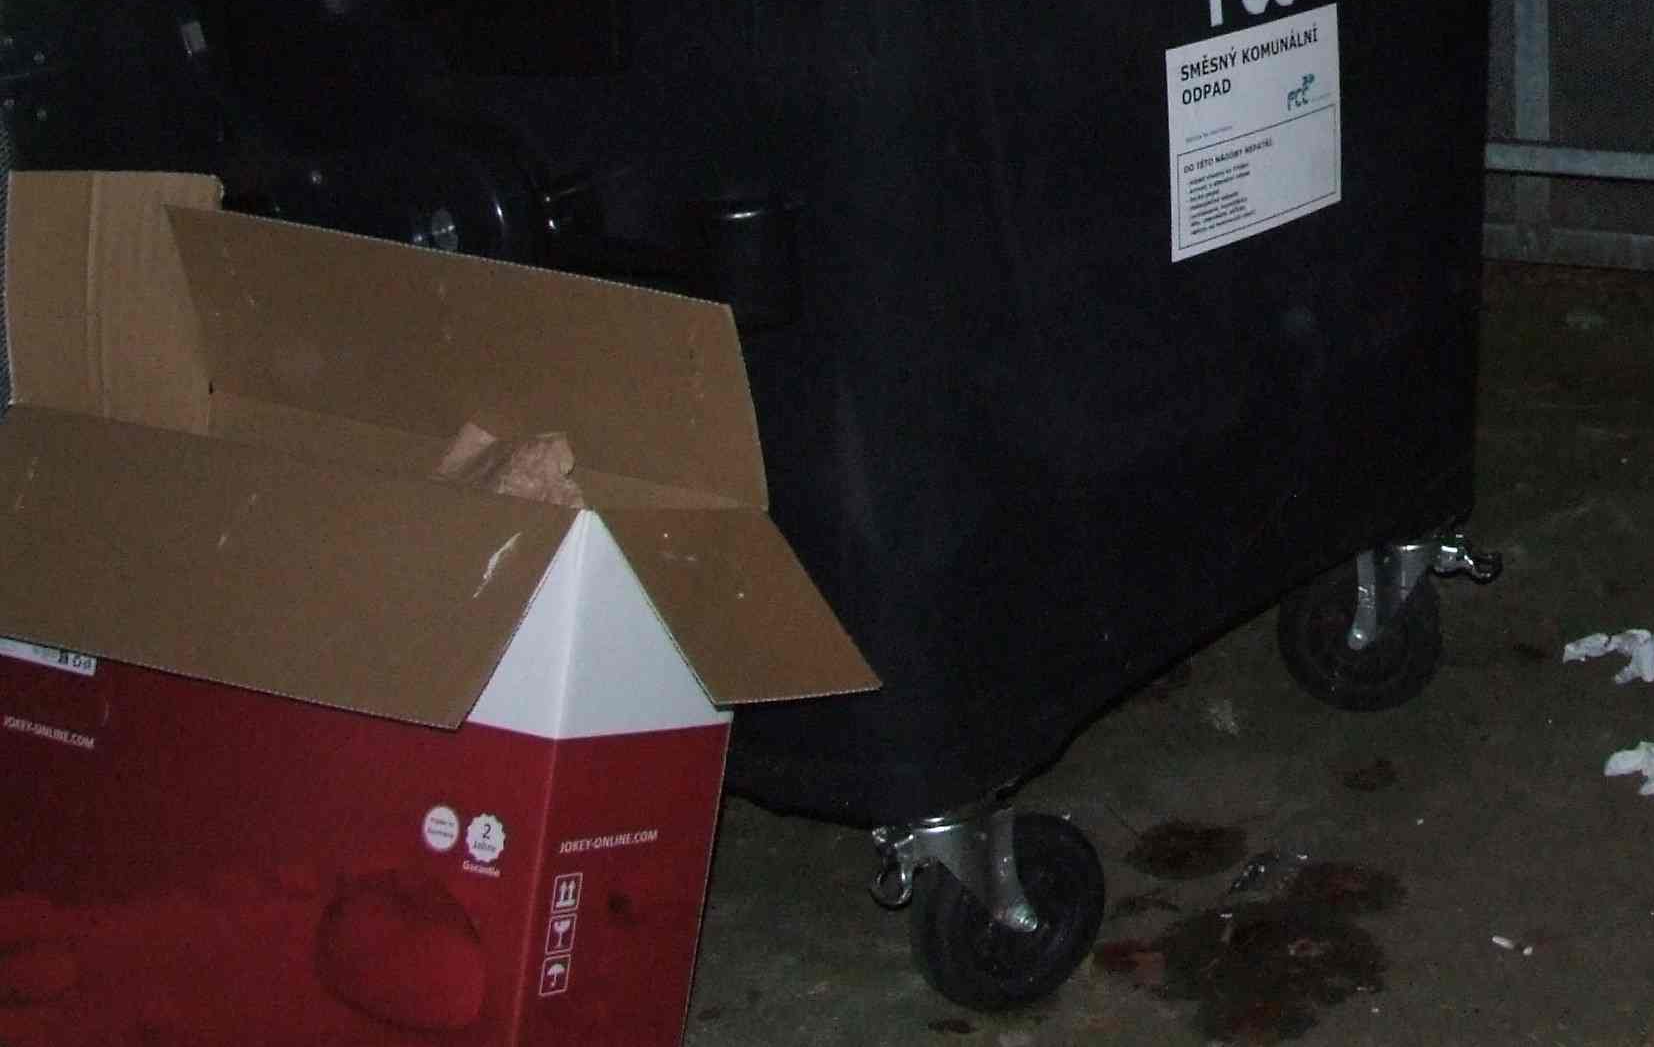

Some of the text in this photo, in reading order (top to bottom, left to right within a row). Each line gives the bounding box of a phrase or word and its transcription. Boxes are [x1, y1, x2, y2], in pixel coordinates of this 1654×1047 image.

[1180, 22, 1320, 82] SMĚSNÝ KOMUNÁLNÍ
[1181, 80, 1232, 105] ODPAD
[482, 823, 492, 840] 2
